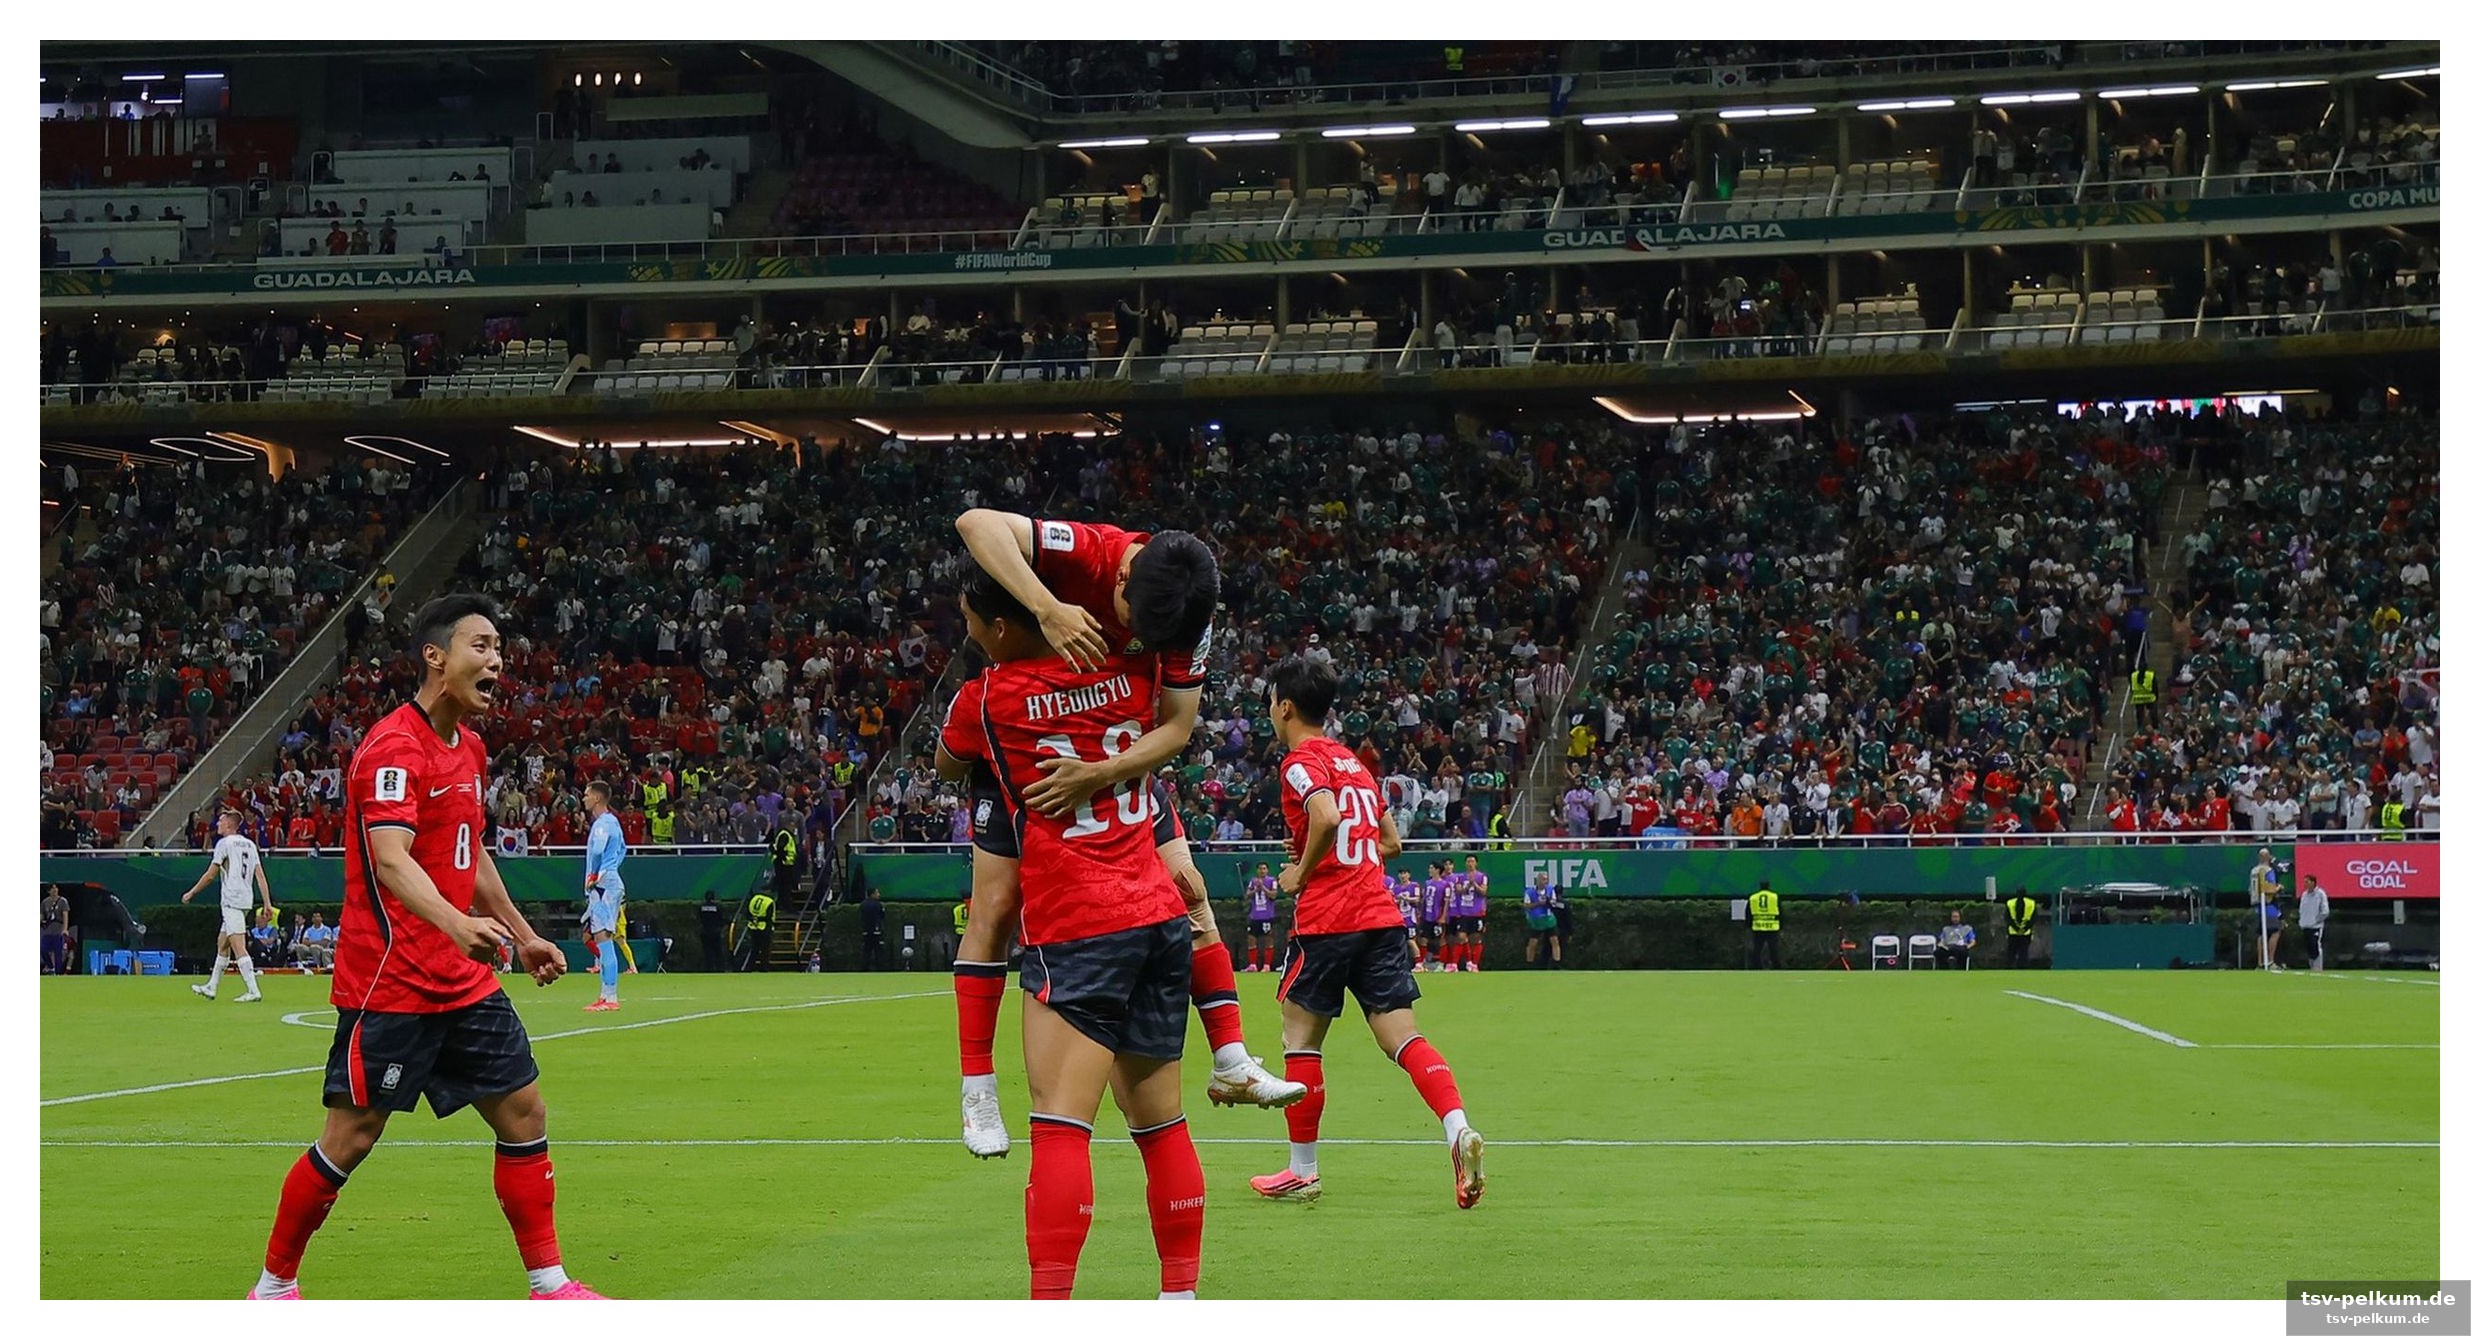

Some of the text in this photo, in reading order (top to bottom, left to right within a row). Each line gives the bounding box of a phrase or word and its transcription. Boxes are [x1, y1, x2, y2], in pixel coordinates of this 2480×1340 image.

[2349, 190, 2405, 209] COPA
[955, 252, 1051, 269] #FIFAWorldCup
[254, 269, 475, 289] GUADALAJARA
[1026, 674, 1132, 721] HYEONGYU
[454, 823, 471, 870] 8
[241, 852, 248, 880] 6
[1524, 859, 1608, 888] FIFA
[2346, 860, 2418, 874] GOAL
[2360, 875, 2406, 888] GOAL
